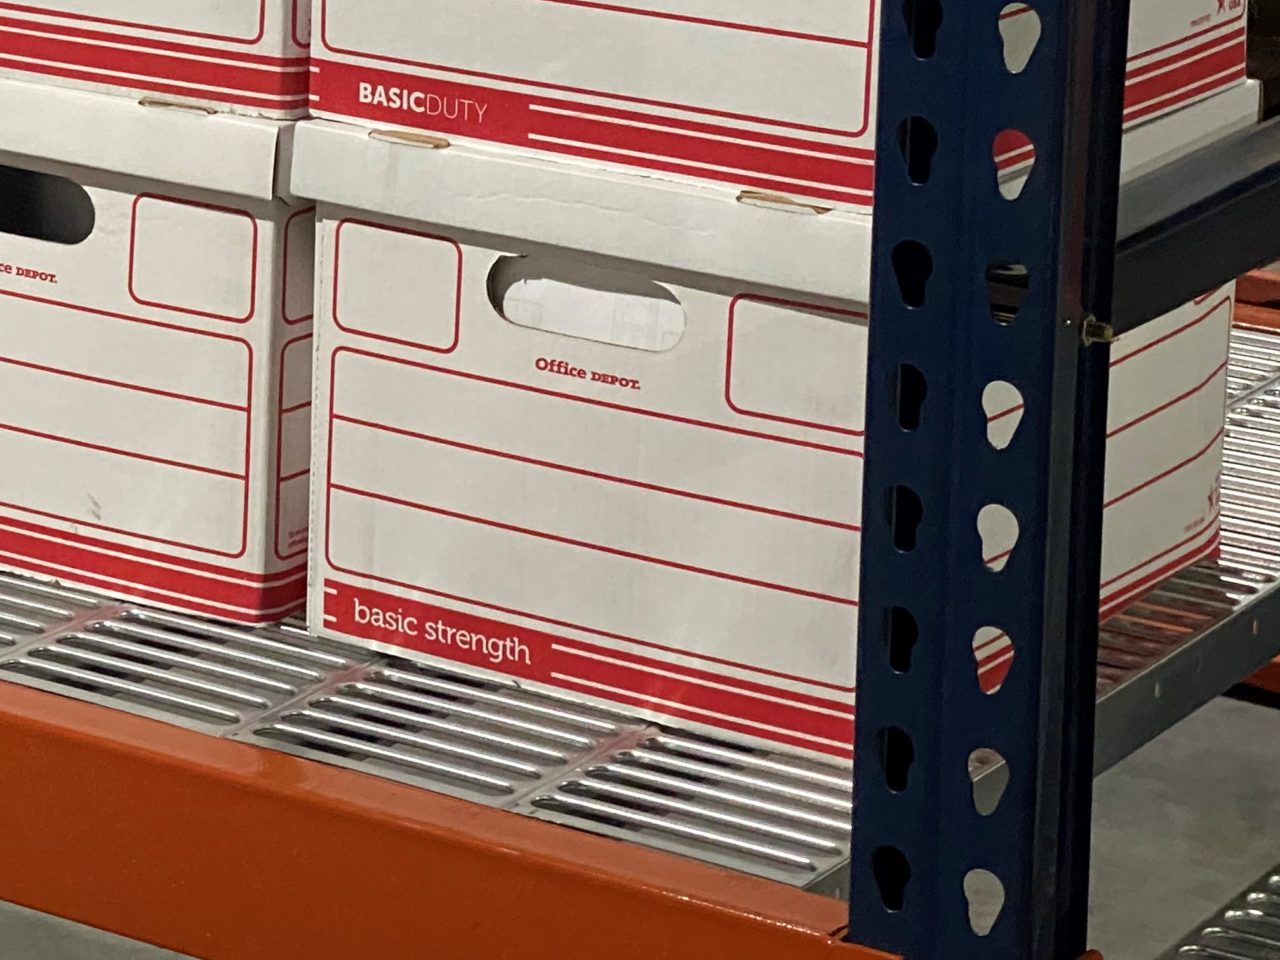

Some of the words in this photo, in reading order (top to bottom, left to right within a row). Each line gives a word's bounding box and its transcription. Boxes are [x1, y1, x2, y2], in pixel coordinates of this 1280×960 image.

[535, 357, 587, 379] Office
[353, 597, 418, 636] basic
[424, 619, 532, 665] strength
